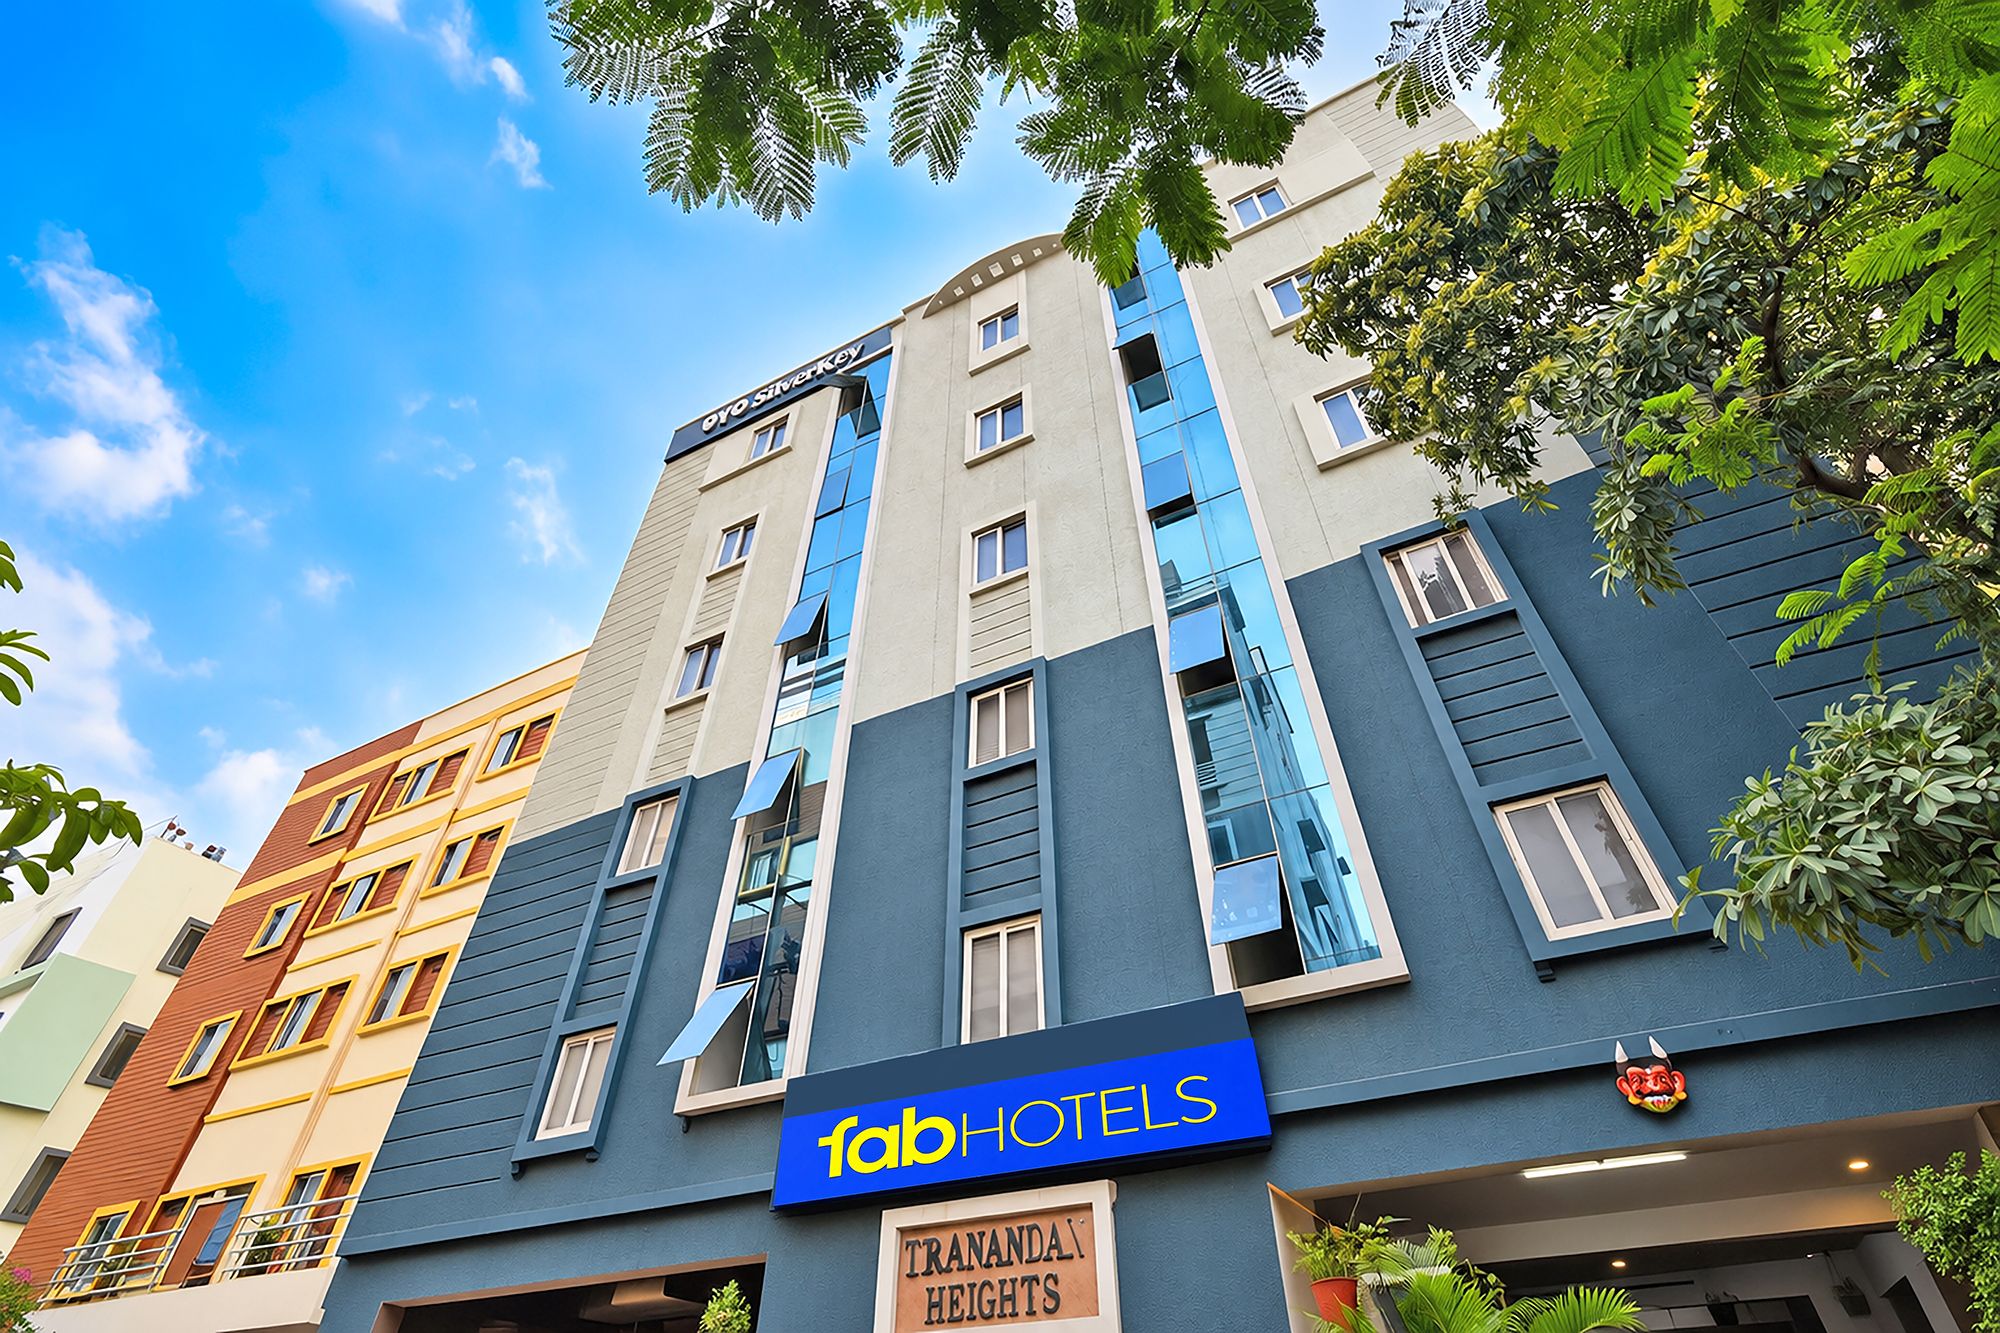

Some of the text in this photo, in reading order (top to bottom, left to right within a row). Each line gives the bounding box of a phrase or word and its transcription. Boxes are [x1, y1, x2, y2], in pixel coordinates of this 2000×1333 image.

[702, 343, 865, 433] OYO SilverKey
[817, 1074, 1217, 1178] fabHOTELS
[924, 1273, 1061, 1325] HEIGHTS
